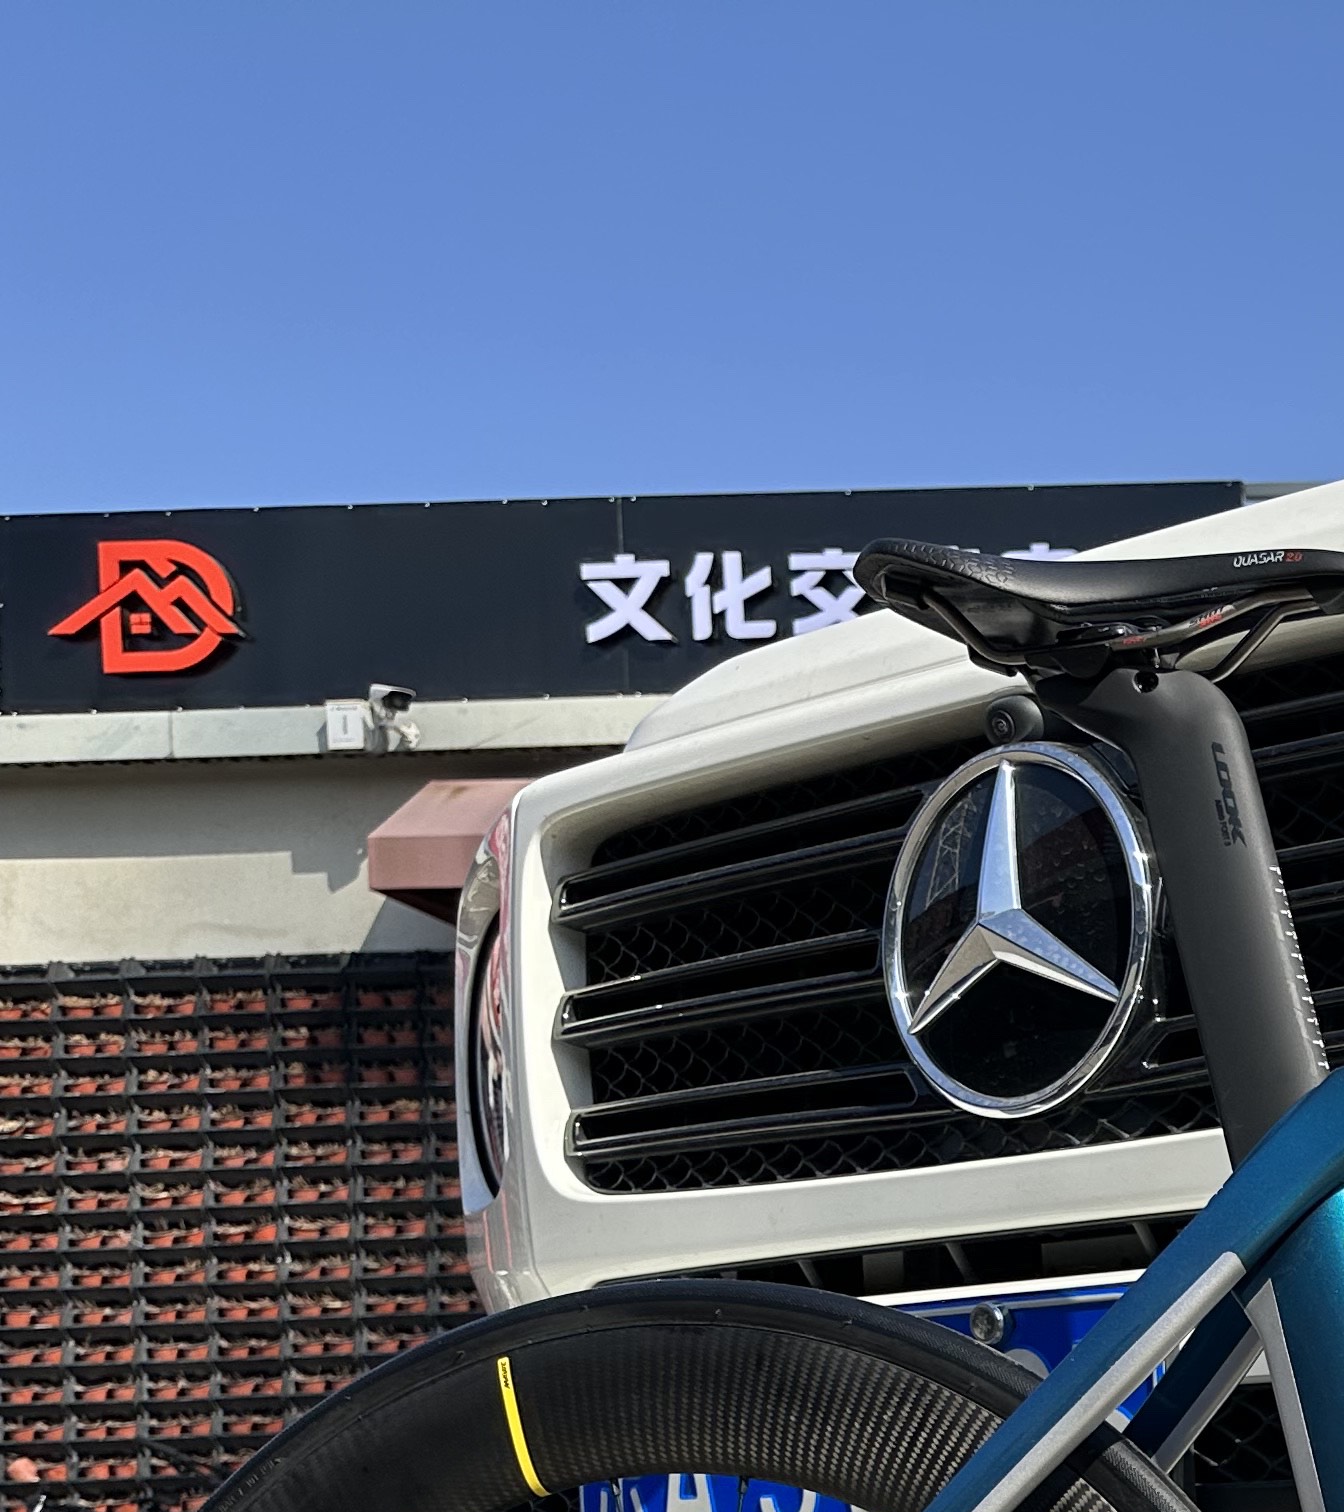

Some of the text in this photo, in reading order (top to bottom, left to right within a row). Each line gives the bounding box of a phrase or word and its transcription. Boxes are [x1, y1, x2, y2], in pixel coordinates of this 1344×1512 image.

[580, 543, 1078, 644] 文化交
[1233, 550, 1285, 568] QUASAR
[1211, 742, 1247, 848] LOOK
